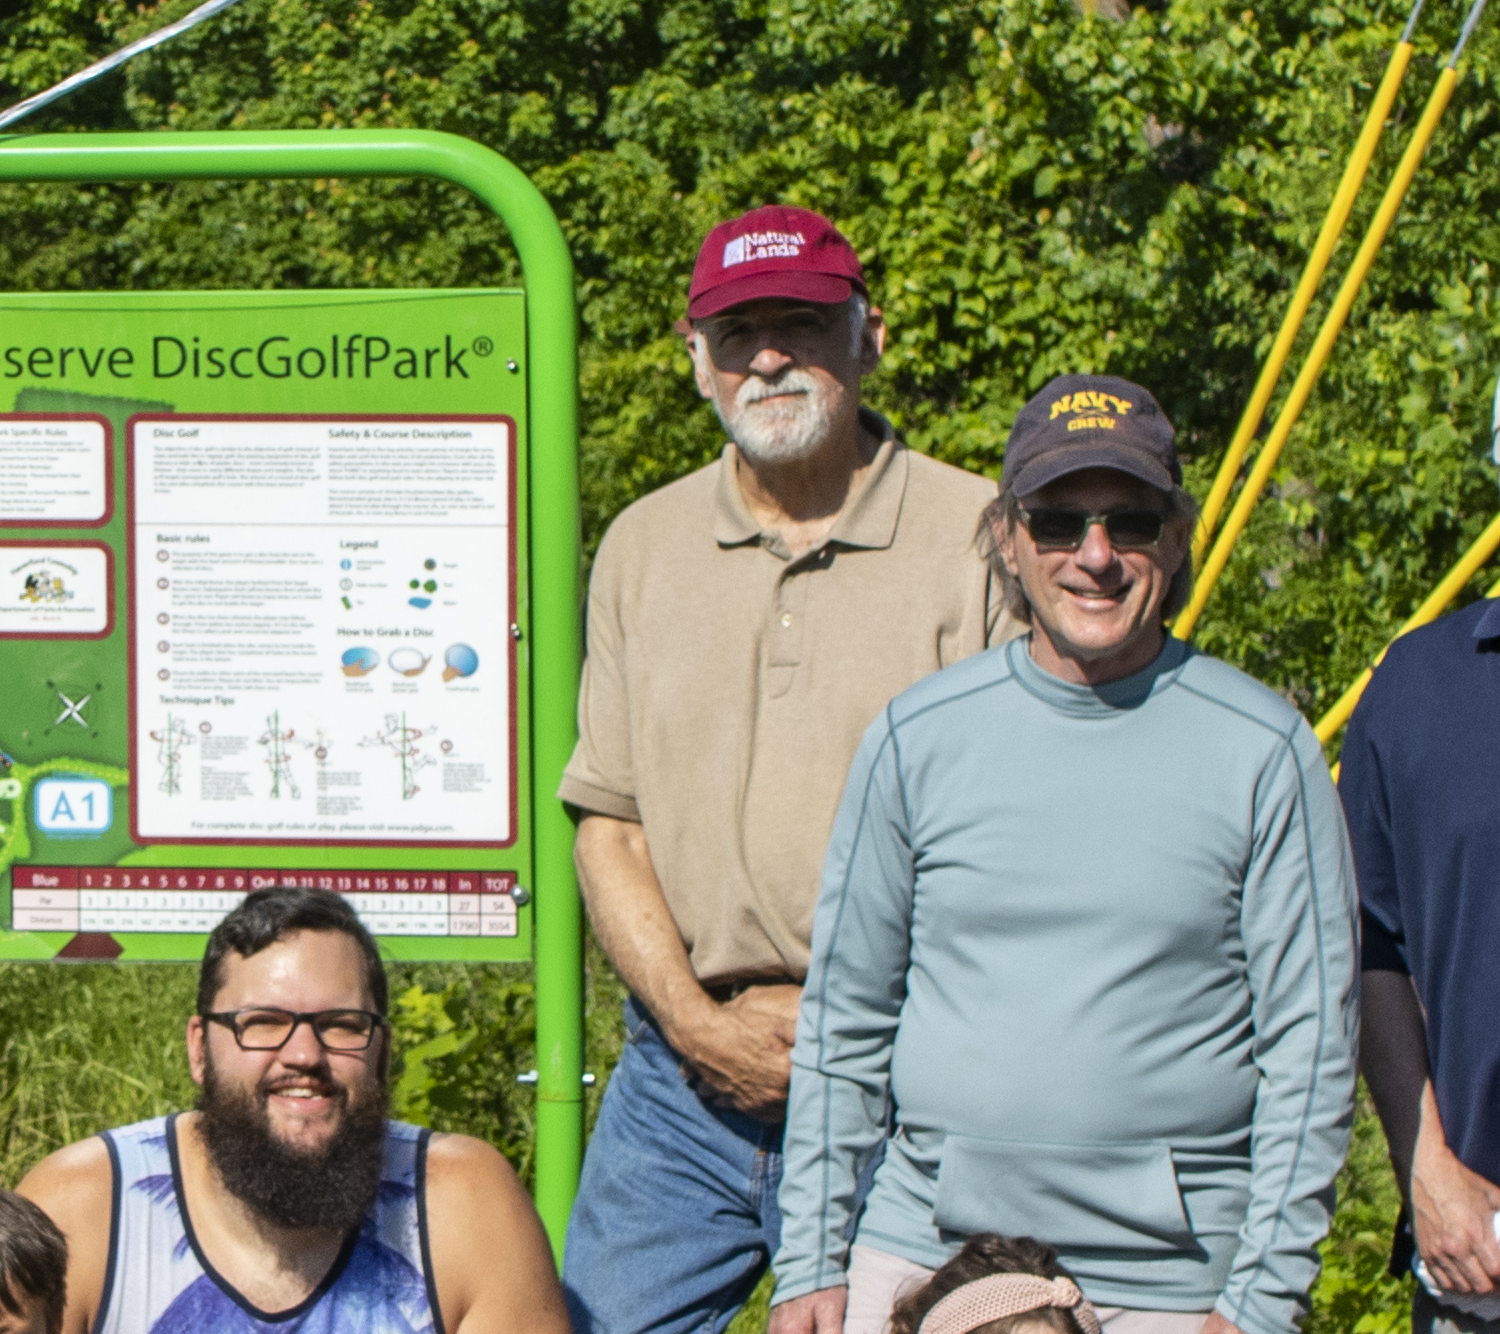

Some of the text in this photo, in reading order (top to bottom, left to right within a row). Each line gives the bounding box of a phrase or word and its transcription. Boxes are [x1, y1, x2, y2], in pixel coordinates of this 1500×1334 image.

[744, 231, 806, 248] Natural
[745, 243, 800, 261] Lands
[1050, 390, 1132, 420] NAVY
[1067, 417, 1116, 432] CREW
[153, 428, 200, 438] Disc Golf
[328, 429, 360, 440] Safety
[374, 429, 410, 439] Course
[412, 429, 473, 440] Description
[156, 534, 210, 543] Basic rules
[339, 539, 379, 551] Legend
[337, 627, 360, 636] How
[363, 628, 374, 636] to
[376, 627, 402, 637] Grab
[412, 627, 434, 637] Disc
[159, 695, 235, 705] Technique Tips
[32, 873, 60, 887] Blue
[85, 875, 93, 887] 1
[103, 875, 112, 887] 2
[122, 875, 131, 887] 3
[140, 875, 150, 887] 4
[159, 875, 168, 887] 5
[178, 876, 187, 888] 6
[197, 876, 206, 888] 7
[215, 876, 225, 888] 8
[234, 876, 244, 888] 9
[319, 878, 333, 890] 12
[337, 878, 351, 890] 13
[356, 878, 370, 890] 14
[374, 878, 389, 890] 15
[394, 878, 409, 890] 16
[413, 878, 427, 890] 17
[432, 878, 446, 890] 18
[457, 878, 472, 890] In
